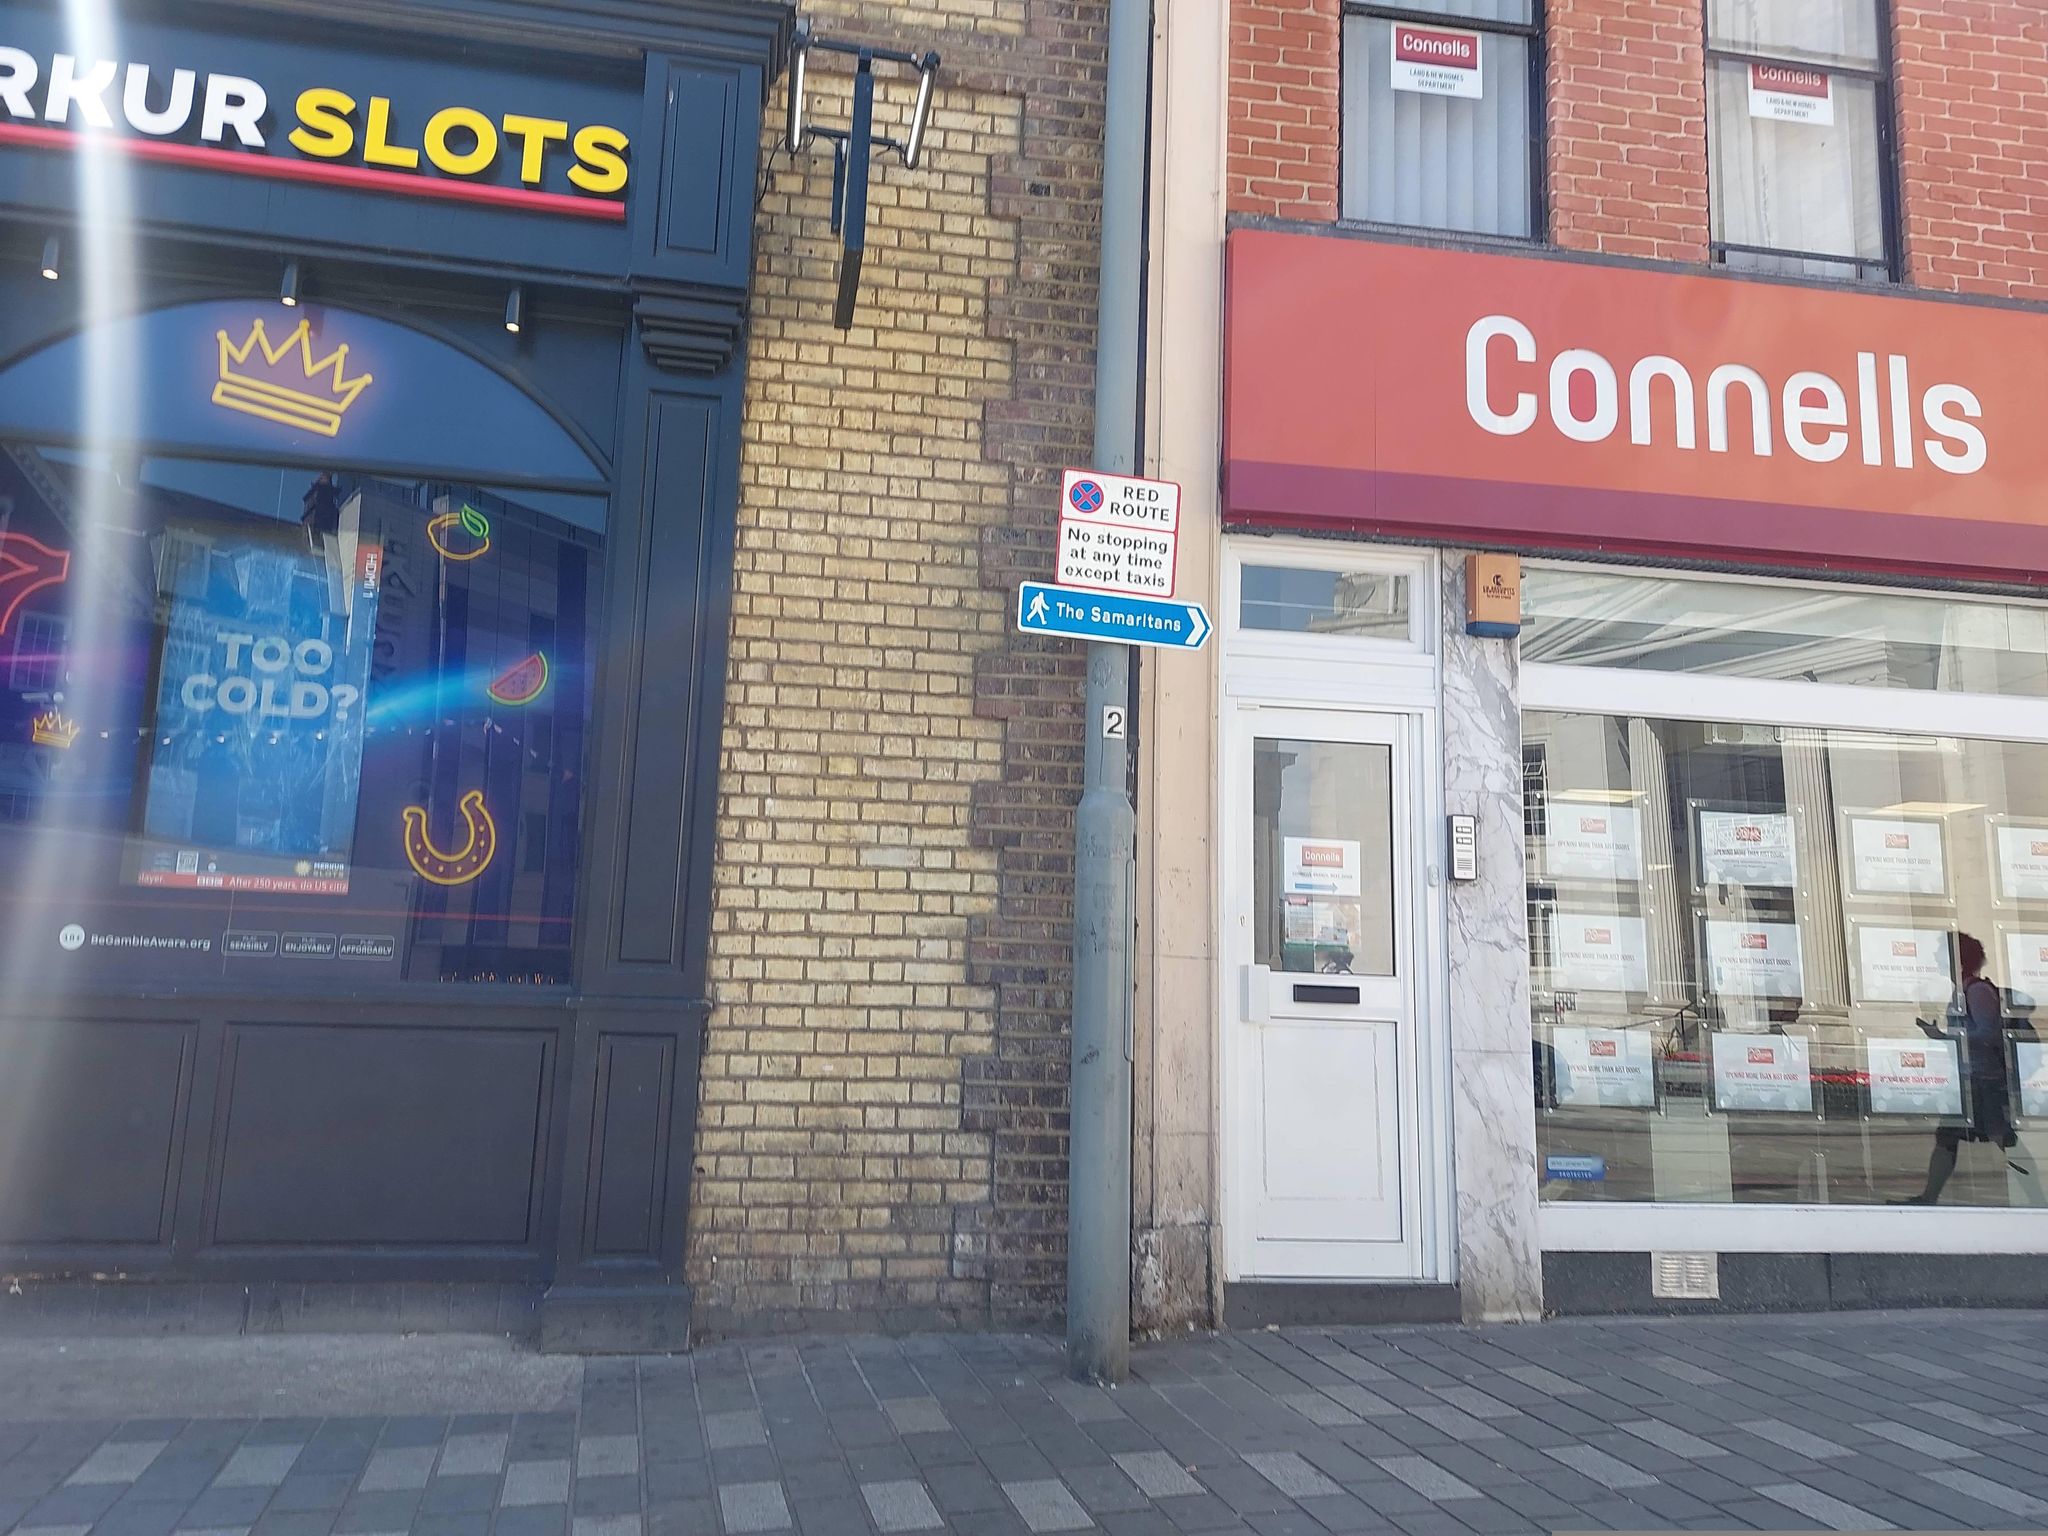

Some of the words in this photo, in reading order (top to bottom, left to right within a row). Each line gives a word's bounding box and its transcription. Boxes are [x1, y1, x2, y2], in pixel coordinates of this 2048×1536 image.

[1403, 33, 1470, 58] Connells
[1759, 65, 1821, 87] Connells
[288, 88, 629, 193] SLOTS
[1466, 314, 1988, 474] Connells
[1124, 486, 1159, 502] RED
[1110, 502, 1169, 522] ROUTE
[1068, 527, 1091, 543] No
[1097, 532, 1168, 555] stopping
[1070, 547, 1086, 560] at
[1093, 551, 1121, 566] any
[1127, 552, 1162, 569] time
[363, 553, 378, 590] HDMI
[1065, 565, 1120, 582] except
[1127, 570, 1165, 587] taxis
[362, 591, 374, 599] 1
[1056, 602, 1085, 620] The
[1091, 606, 1181, 632] Samaritans
[216, 631, 333, 676] TOO
[181, 673, 359, 721] COLD?
[1107, 712, 1123, 735] 2
[229, 876, 251, 888] After
[90, 933, 211, 952] BeGambleAware.org
[229, 940, 268, 951] SENSIBLY
[285, 942, 331, 953] ENJOYABLY
[340, 944, 392, 956] AFFORDABLY
